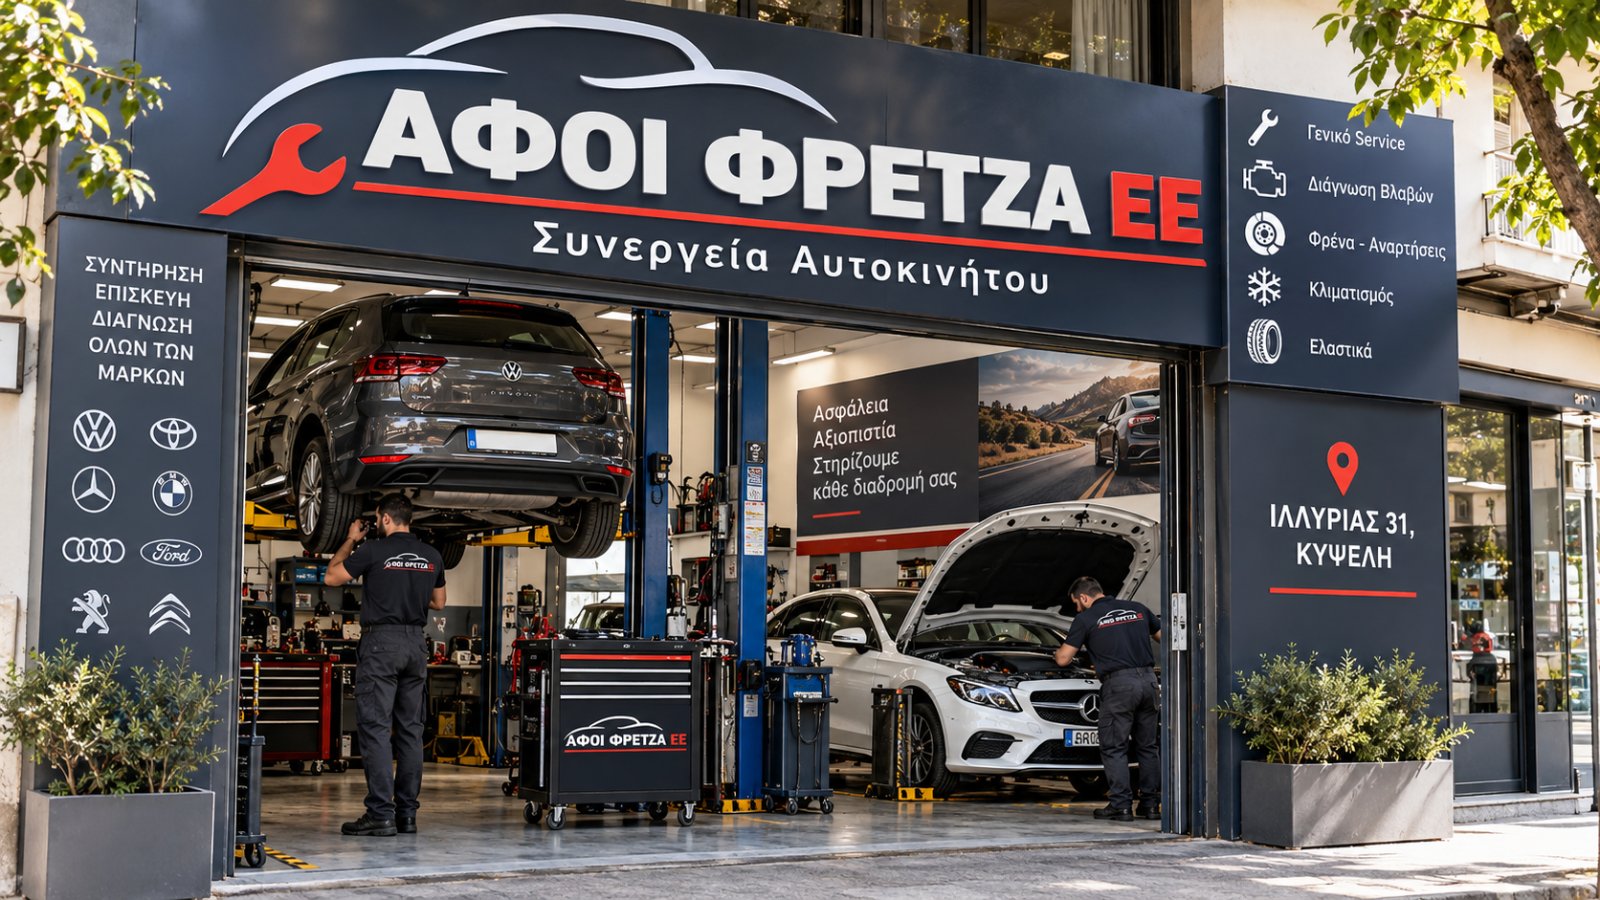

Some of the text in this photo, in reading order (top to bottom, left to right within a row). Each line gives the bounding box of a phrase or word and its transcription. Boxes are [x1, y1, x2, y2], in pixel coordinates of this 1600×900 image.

[1307, 124, 1406, 151] Γενικό Service
[361, 87, 1204, 244] ΑΦΟΙ ΦΡΕΤΖΑ ΕΕ
[1308, 176, 1434, 206] Διάγνωση Βλαβών
[532, 220, 1049, 296] Συνεργεία Αυτοκινήτου
[1308, 230, 1355, 252] Φρένα
[1369, 237, 1446, 262] Αναρτήσεις
[85, 256, 204, 284] ΣΥΝΤΗΡΗΣΗ
[95, 283, 192, 309] ΕΠΙΣΚΕΥΗ
[1309, 281, 1394, 307] Κλιματισμός
[92, 310, 193, 335] ΔΙΑΓΝΩΣΗ
[89, 337, 195, 361] ΟΛΩΝ ΤΩΝ
[1310, 338, 1373, 359] Ελαστικά
[98, 365, 186, 387] ΜΑΡΚΩΝ
[812, 398, 889, 423] Ασφάλεια
[812, 420, 896, 450] Αξιοπιστία
[812, 451, 900, 476] Στηρίζουμε
[813, 470, 957, 501] κάθε διαδρομή σας
[1270, 503, 1415, 539] ΙΛΛΥΡΙΑΣ 31,
[152, 542, 191, 563] Ford
[1296, 542, 1392, 569] ΚΥΨΕΛΗ
[565, 733, 687, 747] ΑΦΟΙ ΦΡΕΤΖΑ ΕΕ
